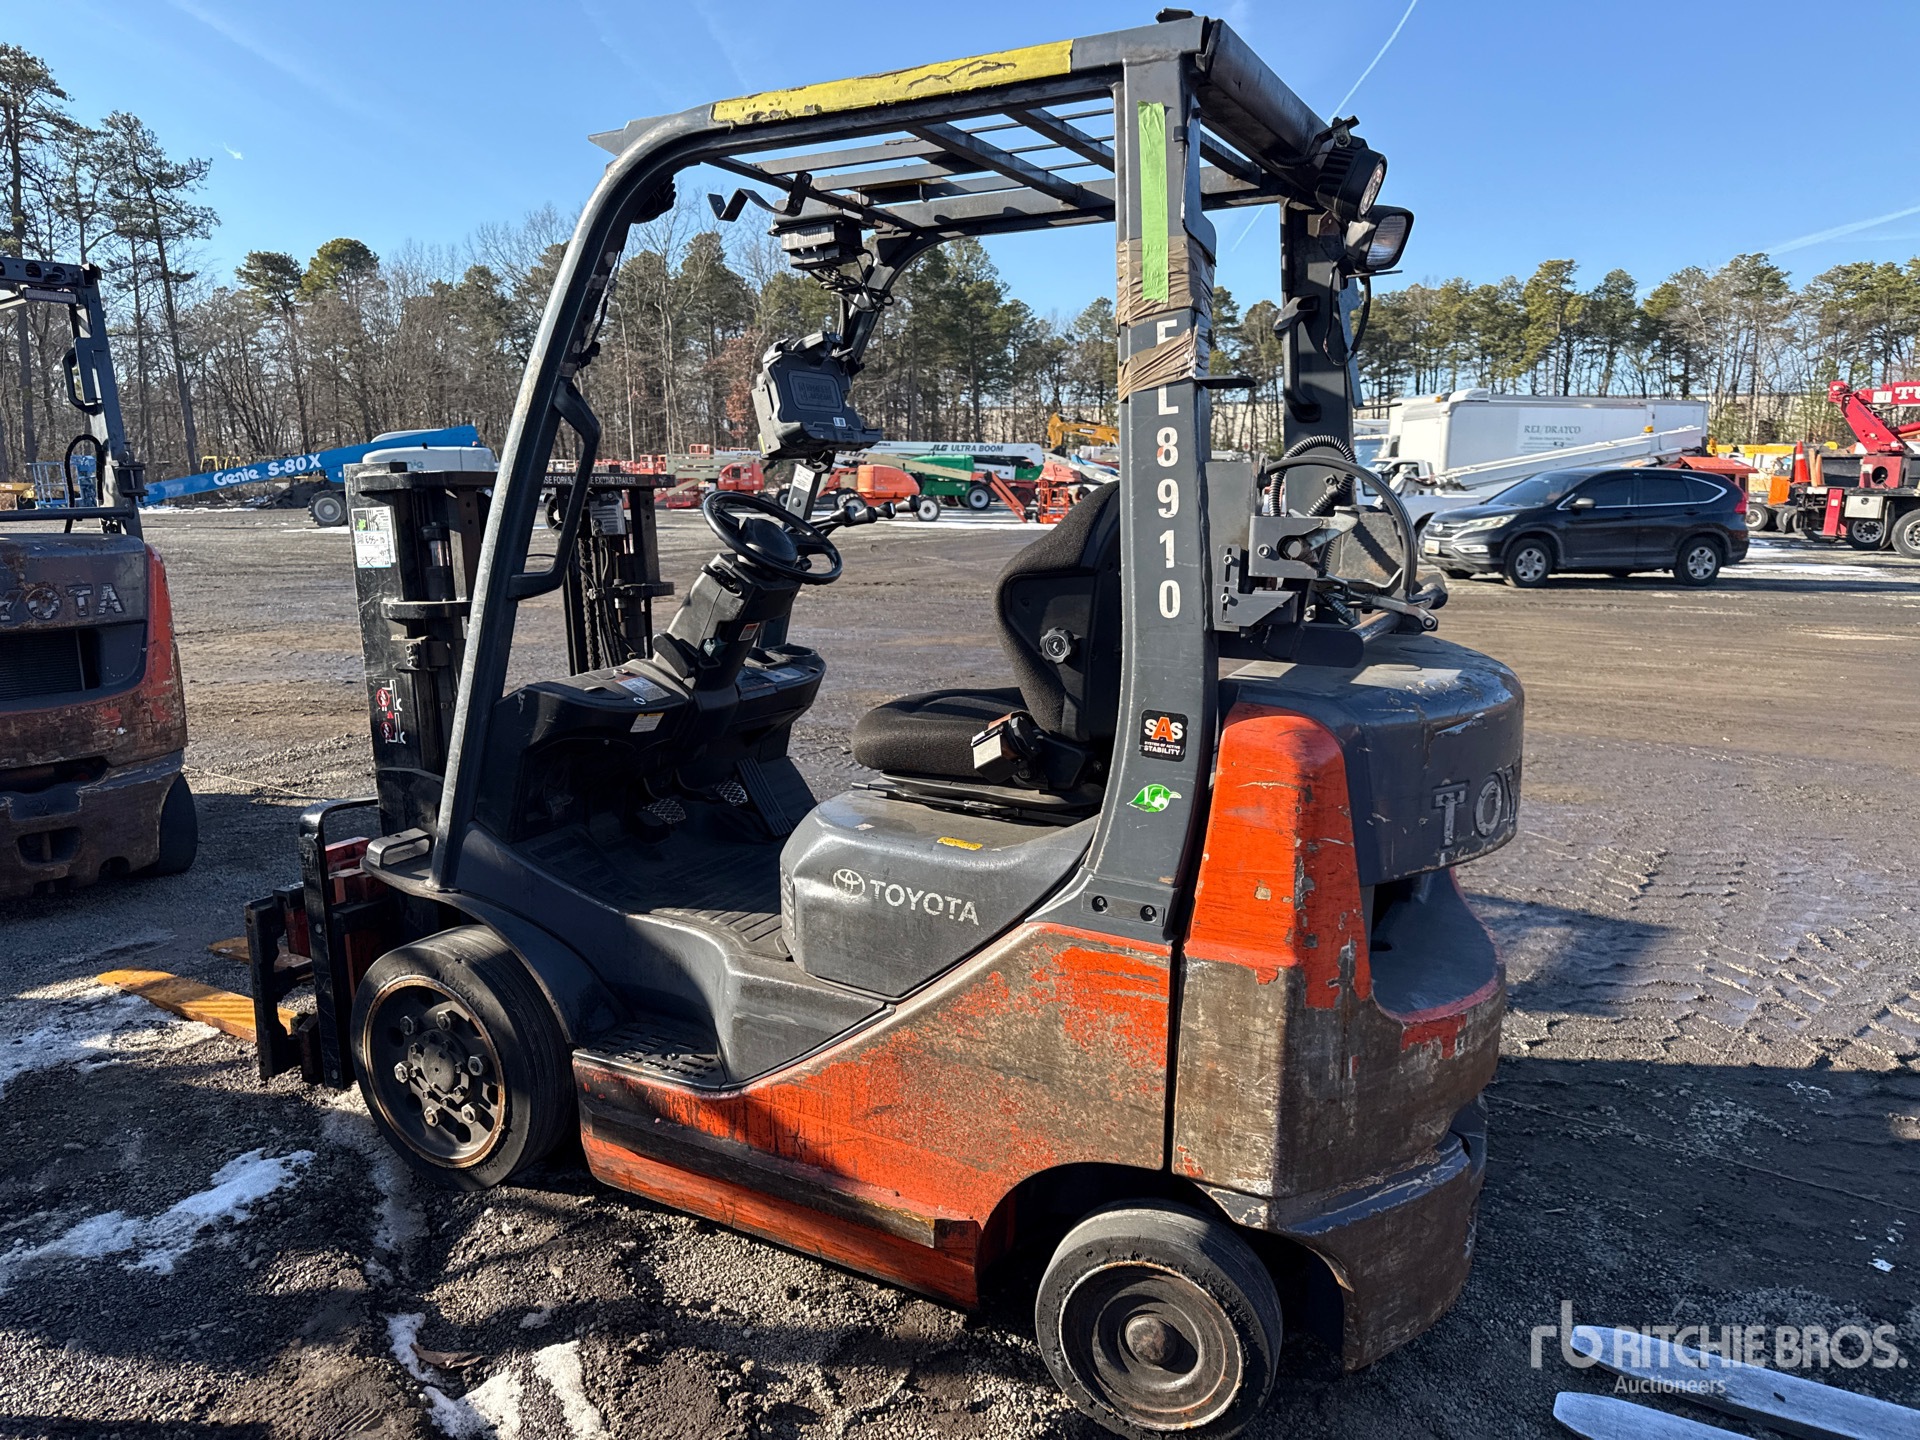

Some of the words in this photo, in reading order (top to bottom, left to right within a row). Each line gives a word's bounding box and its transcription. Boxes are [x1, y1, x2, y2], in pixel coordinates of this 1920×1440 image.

[213, 468, 259, 486] Genie
[1144, 716, 1183, 742] SAS
[1144, 745, 1181, 756] STABILITY
[869, 879, 979, 926] TOYOTA
